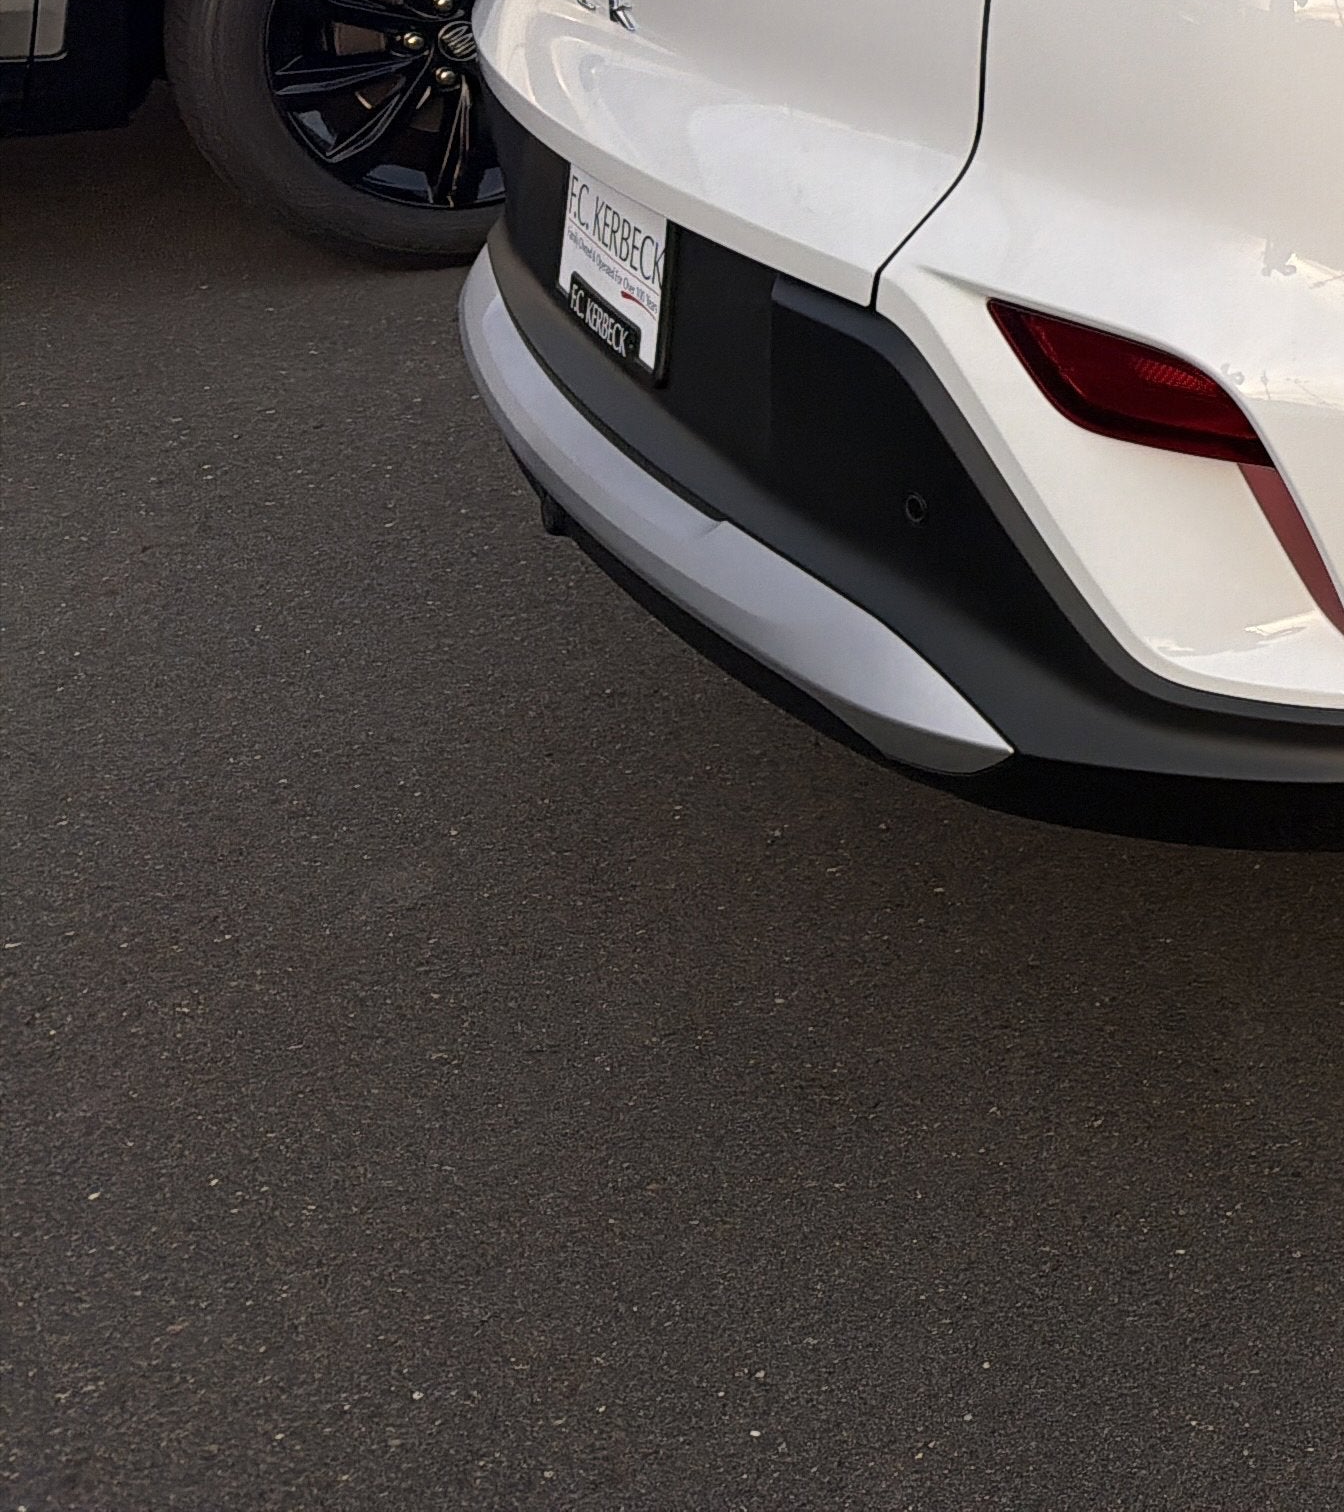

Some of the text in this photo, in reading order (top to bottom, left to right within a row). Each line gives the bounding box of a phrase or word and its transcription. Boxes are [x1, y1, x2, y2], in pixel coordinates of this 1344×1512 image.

[592, 194, 665, 289] KERBECK
[622, 277, 635, 294] Over
[585, 298, 629, 358] KERBECK
